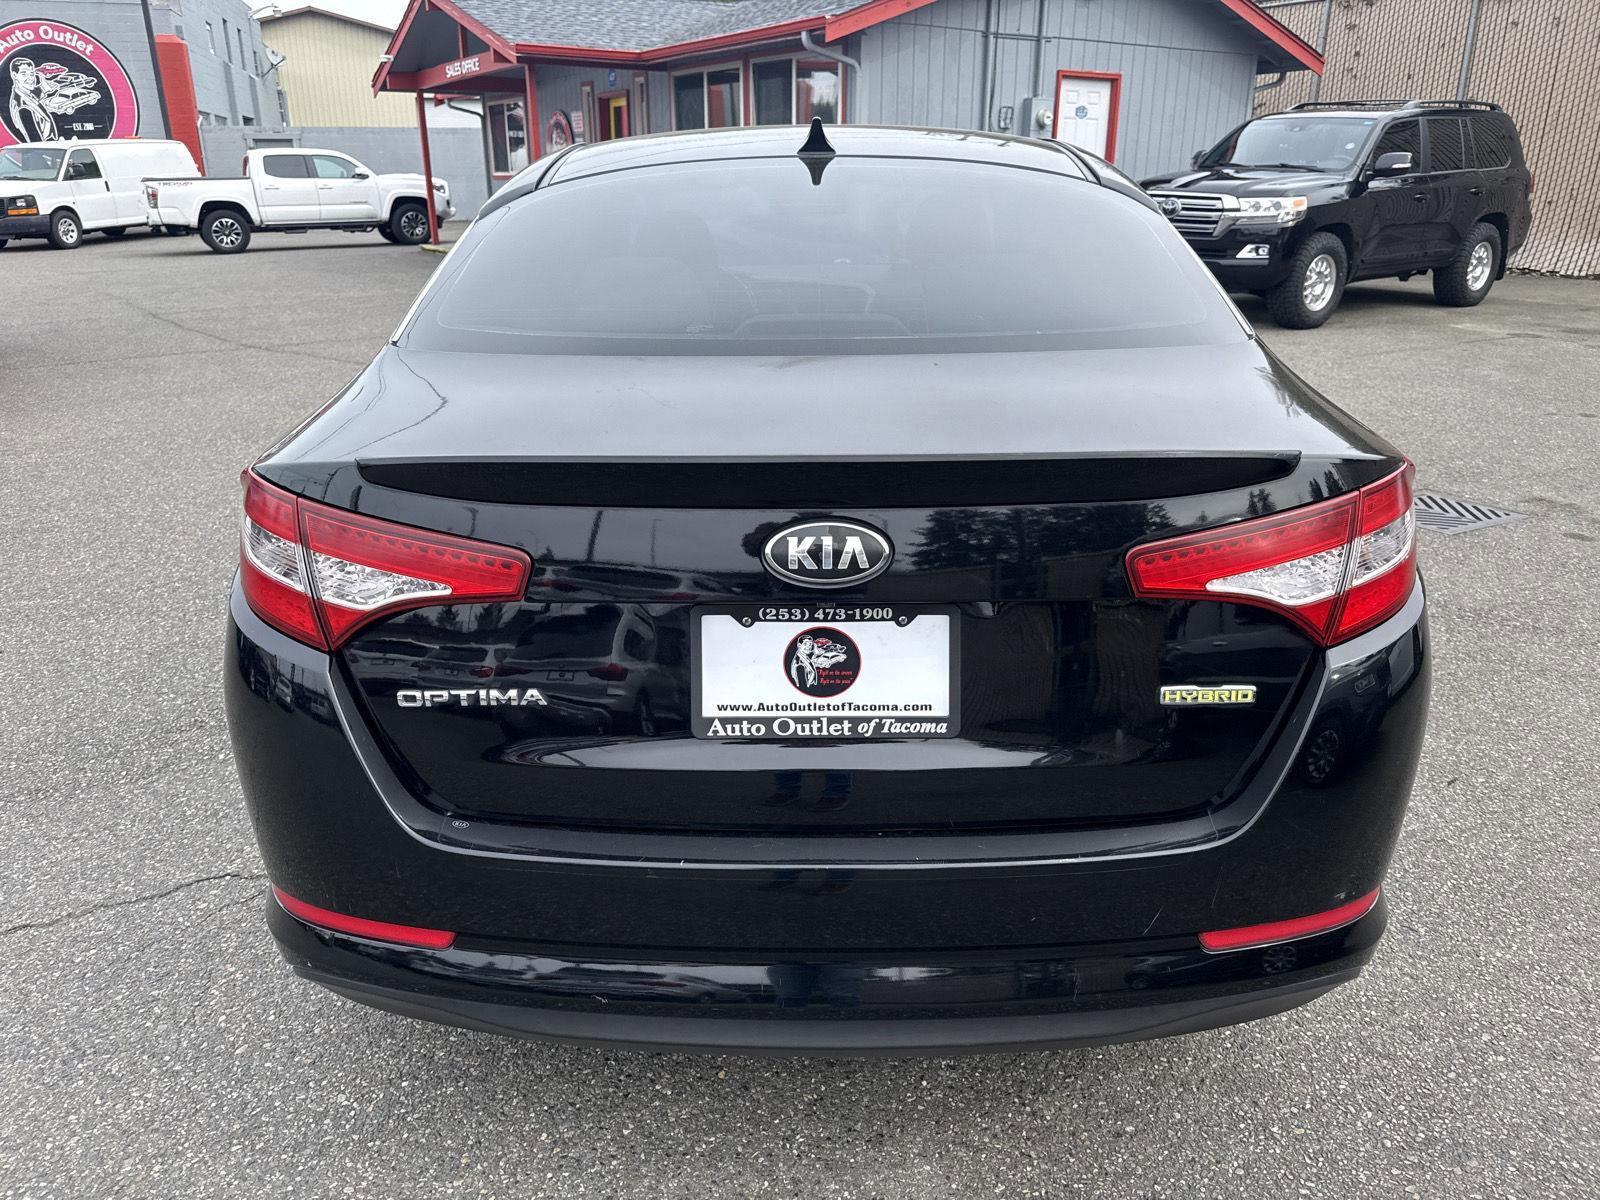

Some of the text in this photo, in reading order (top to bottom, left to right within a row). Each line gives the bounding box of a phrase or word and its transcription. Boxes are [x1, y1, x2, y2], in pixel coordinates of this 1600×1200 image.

[0, 25, 93, 56] Auto Outlet
[445, 57, 480, 78] SALES OFFICE
[786, 535, 870, 570] KIA
[758, 607, 893, 620] (253) 473-1900
[396, 688, 548, 708] OPTIMA
[1163, 688, 1255, 704] HYBRID
[716, 702, 933, 713] www.AutoOutletofTacoma.com
[706, 717, 948, 738] Auto Outlet of Tacoma
